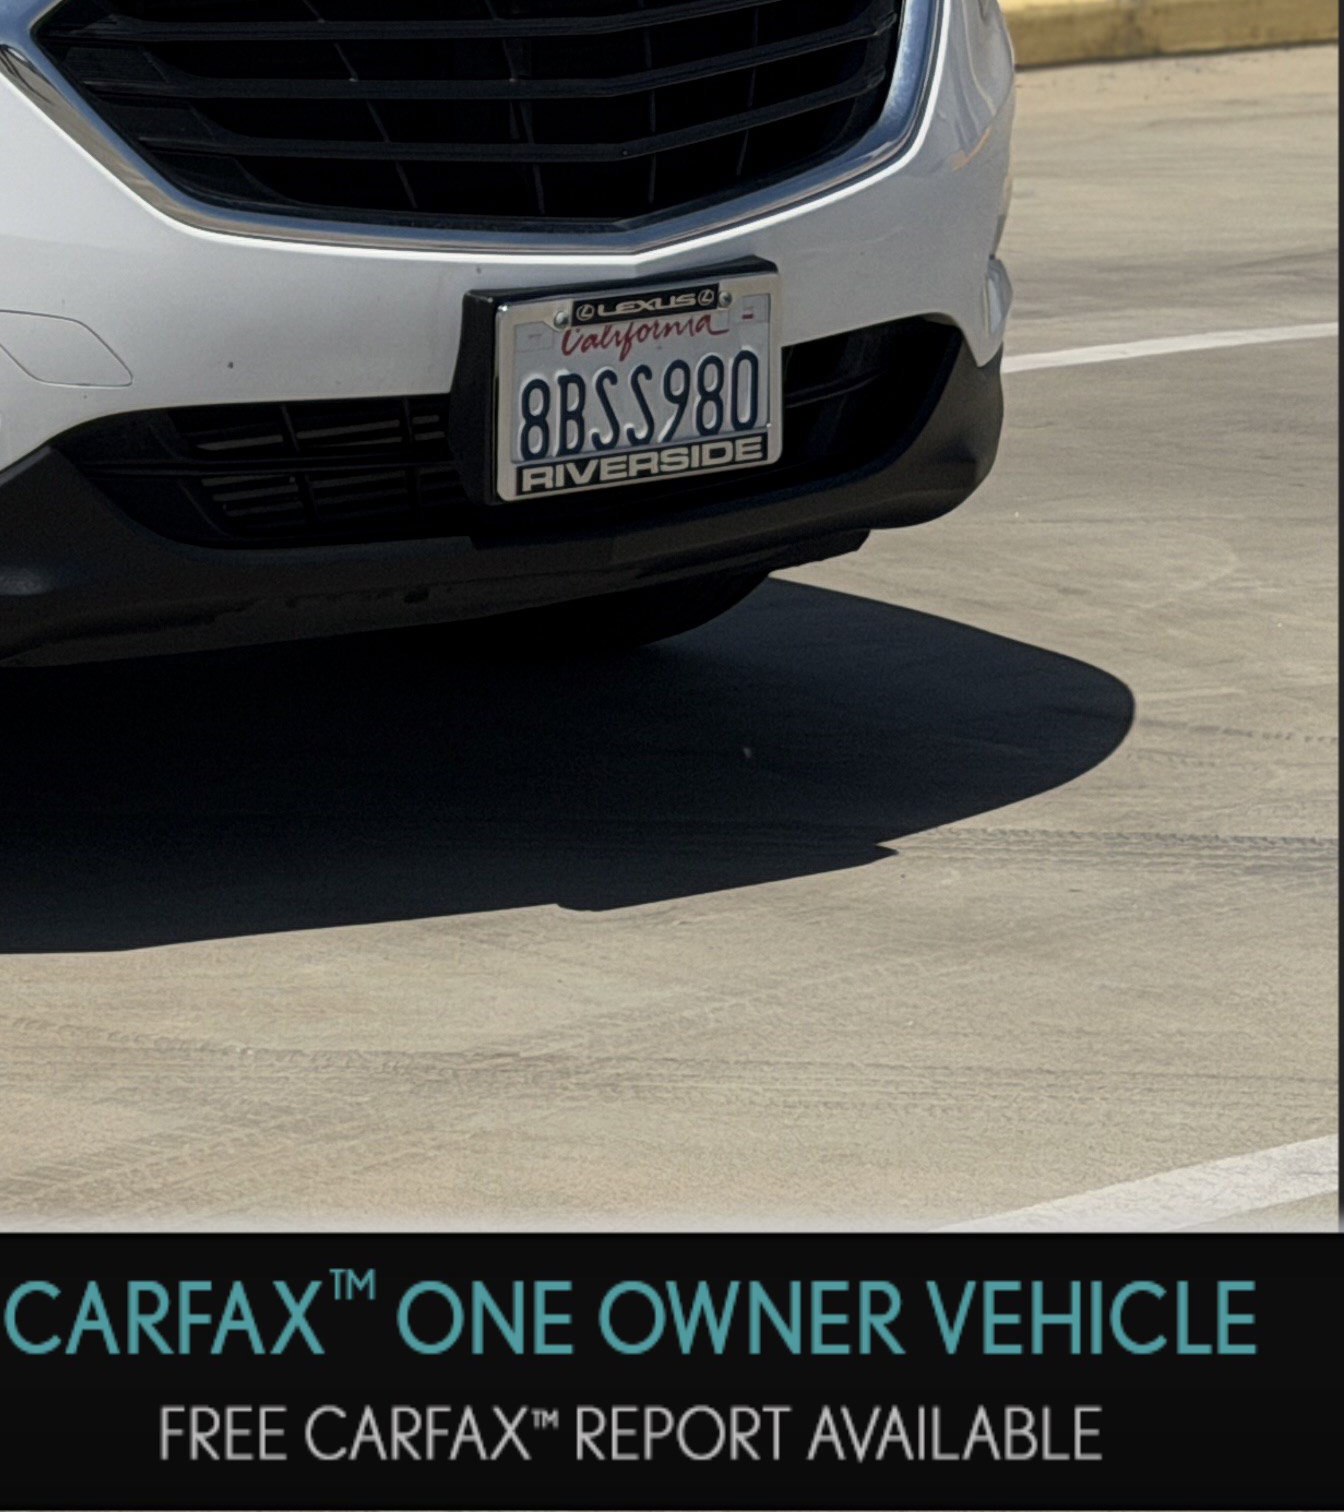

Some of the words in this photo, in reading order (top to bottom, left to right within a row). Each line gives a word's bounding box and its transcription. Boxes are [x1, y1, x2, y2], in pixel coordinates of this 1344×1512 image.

[598, 293, 697, 317] LEXUS
[561, 313, 730, 362] California
[520, 349, 759, 461] 8BSS980
[521, 436, 763, 493] RIVERSIDE
